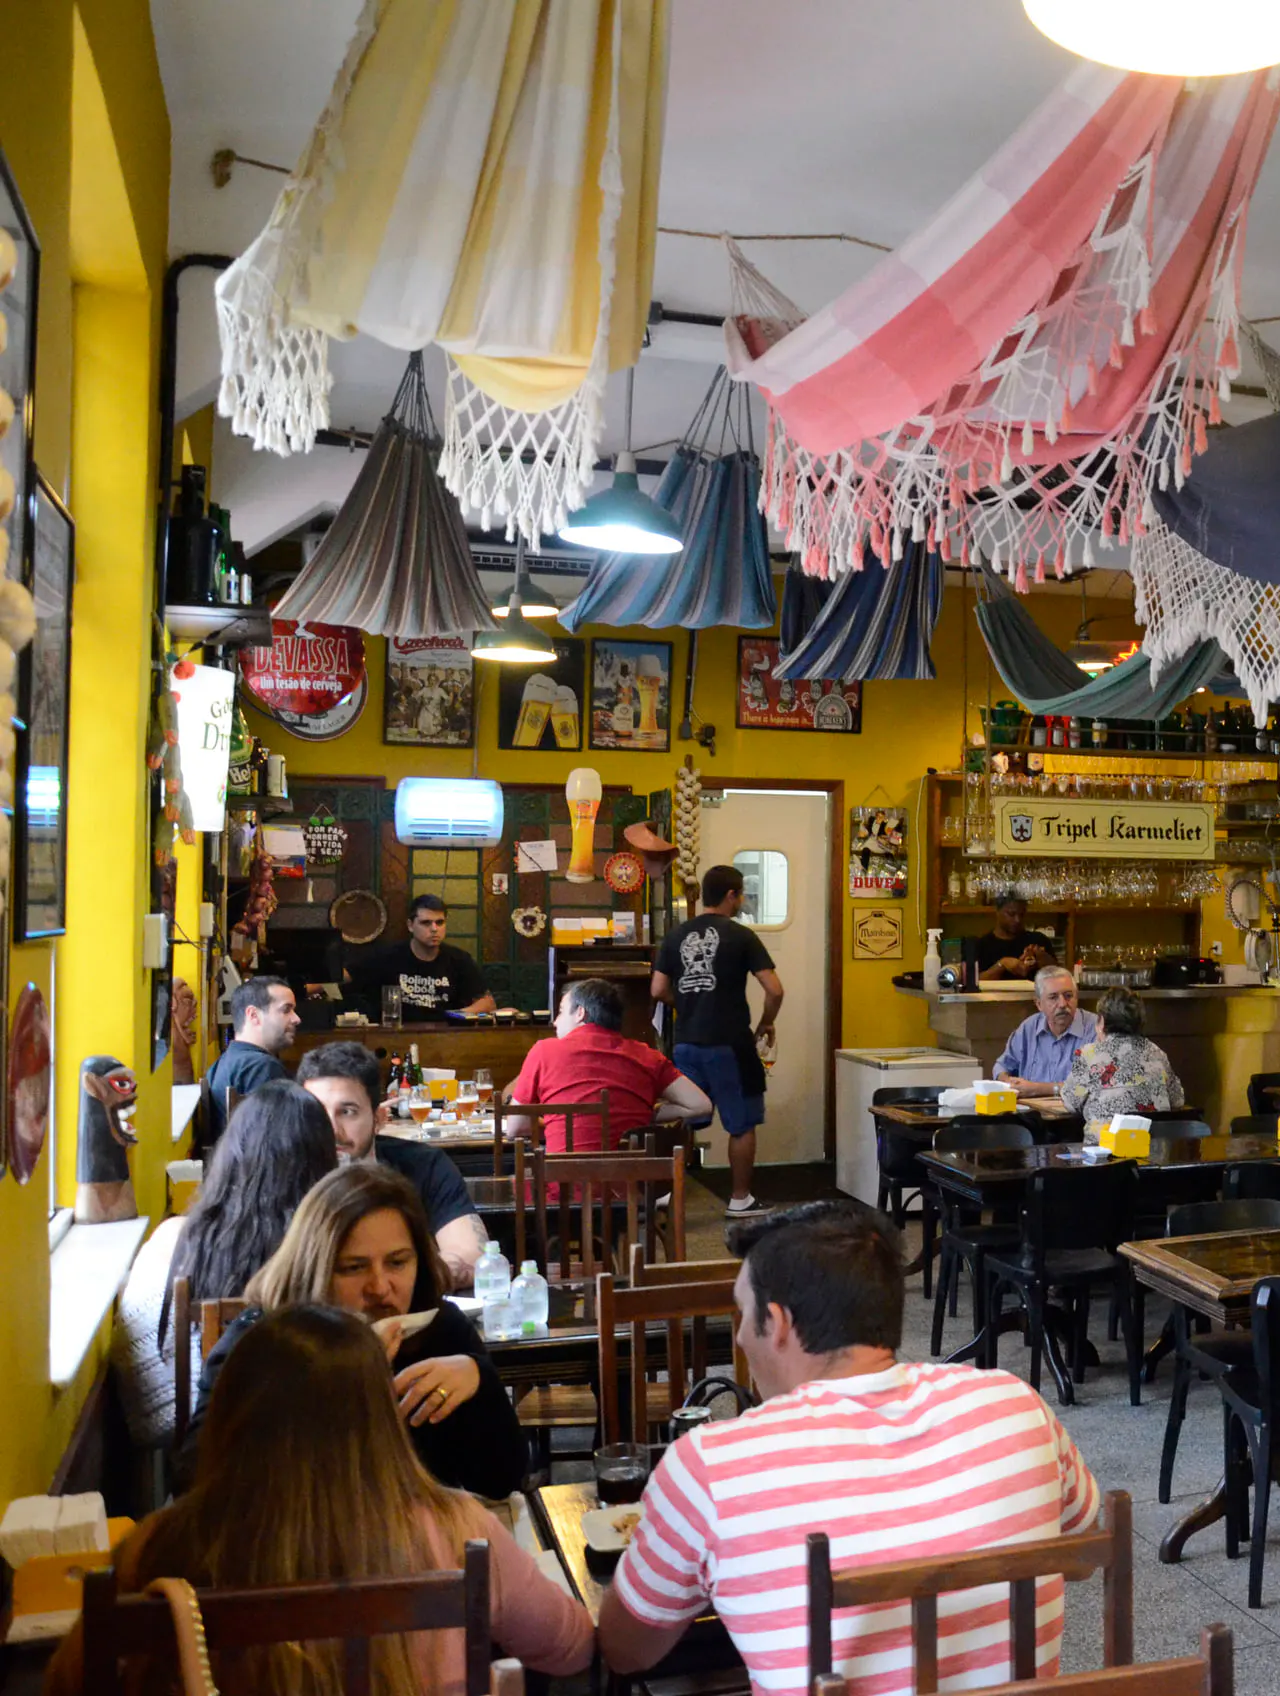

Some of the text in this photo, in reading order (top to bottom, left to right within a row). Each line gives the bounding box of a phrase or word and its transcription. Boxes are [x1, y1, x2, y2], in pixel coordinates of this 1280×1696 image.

[255, 635, 349, 675] DEVASSA
[260, 675, 343, 693] Um tesão de cerveja
[742, 711, 761, 723] There
[1040, 813, 1203, 844] Tripel Karmeliet
[311, 841, 343, 849] BATIDA
[320, 847, 343, 857] SEJA
[853, 876, 905, 890] DUVEL
